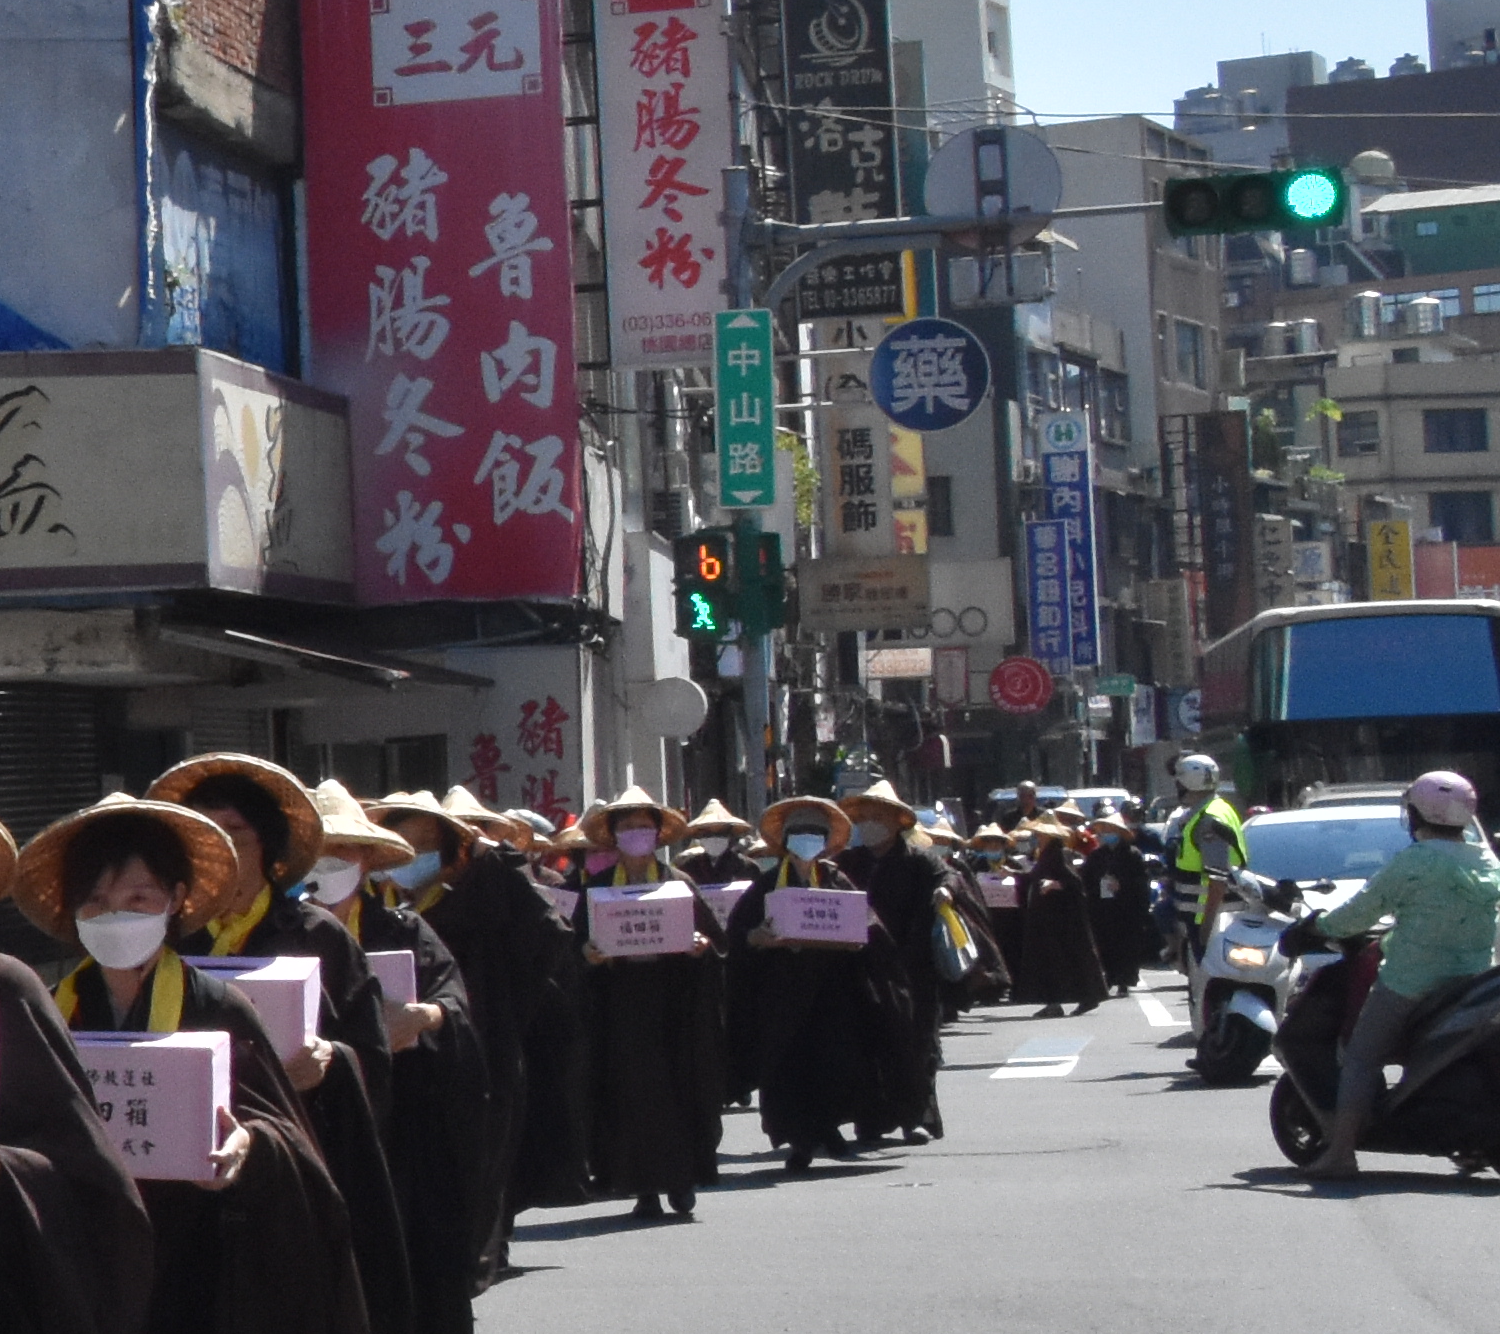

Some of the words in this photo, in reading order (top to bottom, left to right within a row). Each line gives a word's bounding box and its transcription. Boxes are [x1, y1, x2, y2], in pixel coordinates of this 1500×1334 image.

[391, 11, 526, 78] 三元
[795, 70, 837, 89] ROCK
[840, 68, 882, 87] DRUM
[626, 18, 716, 293] 豬腸冬粉
[468, 192, 575, 527] 魯肉飯
[621, 311, 713, 333] (03)336-06
[359, 146, 471, 590] 豬腸冬粉
[727, 341, 763, 476] 中山路
[889, 333, 972, 415] 藥
[99, 1099, 148, 1127] 田箱
